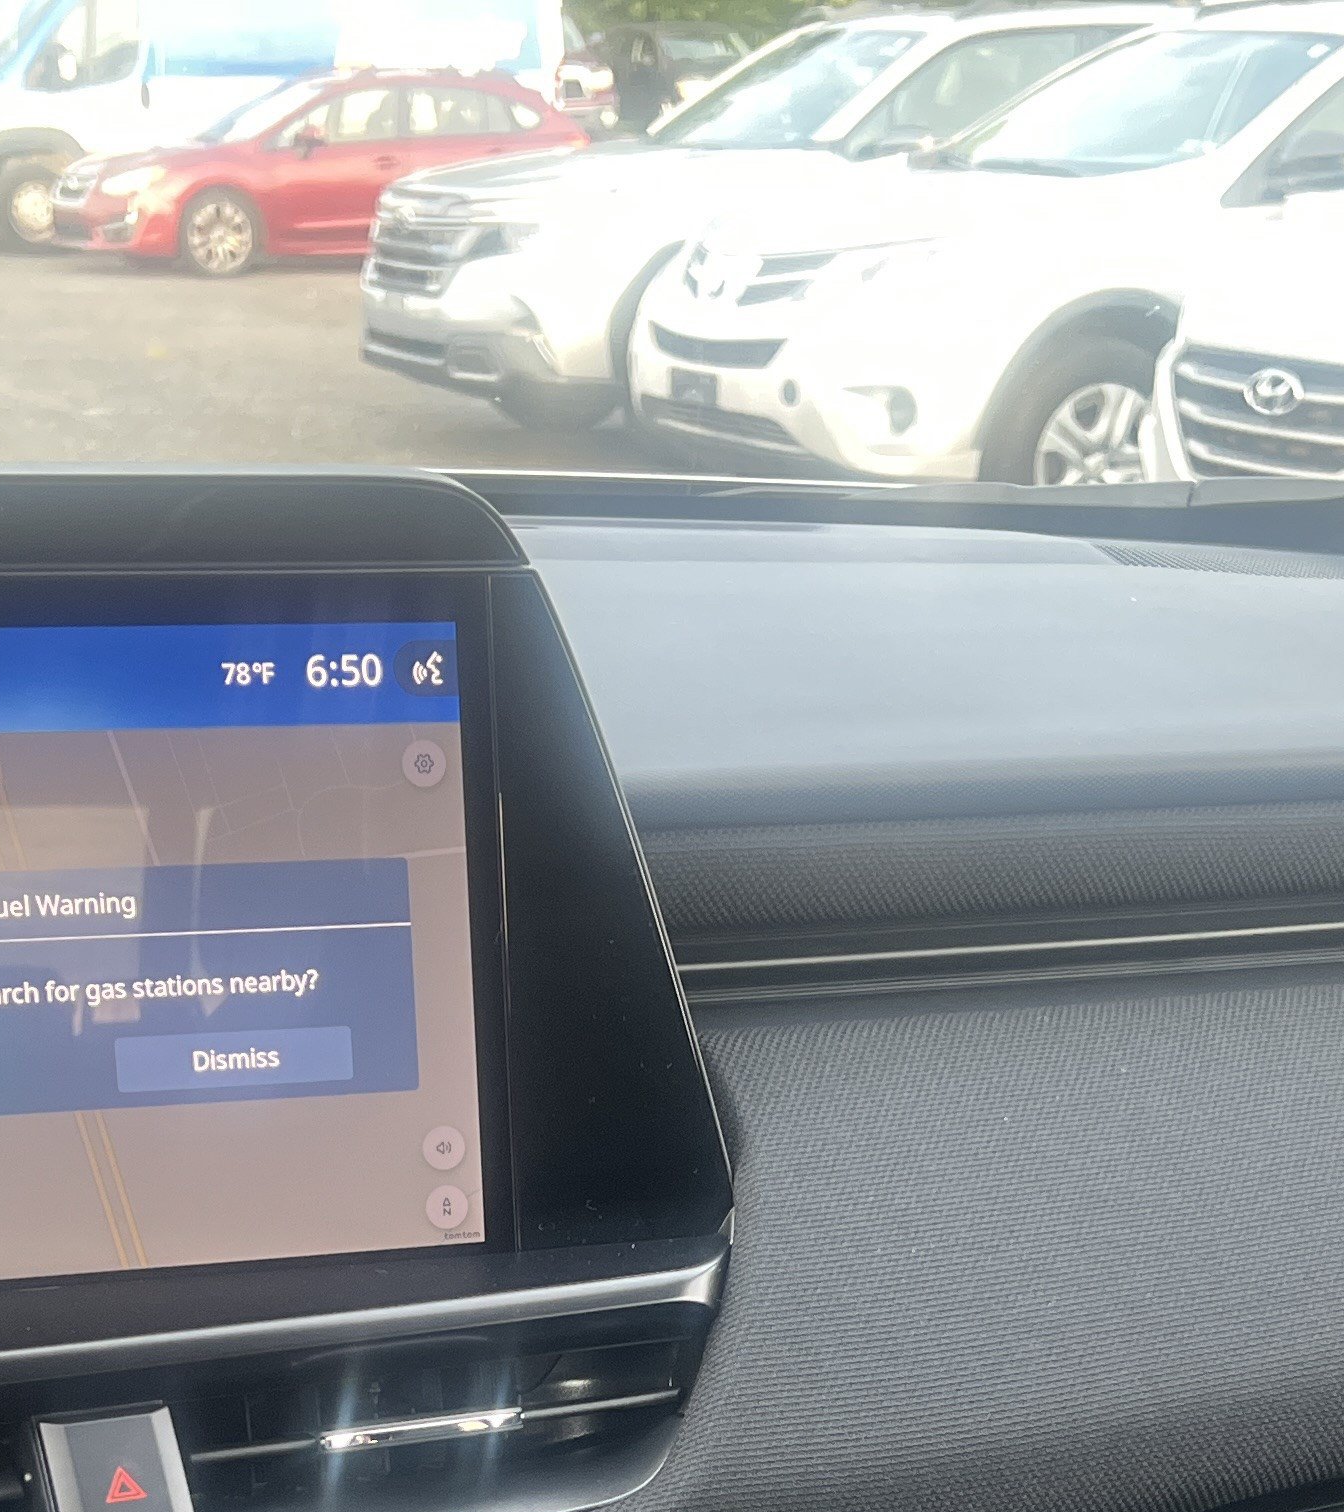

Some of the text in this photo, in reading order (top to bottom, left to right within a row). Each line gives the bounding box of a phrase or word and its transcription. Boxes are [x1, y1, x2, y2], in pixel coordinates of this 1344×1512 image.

[221, 661, 276, 686] 78°F
[306, 653, 384, 688] 6:50
[35, 892, 138, 919] Warning
[44, 979, 80, 1004] for
[85, 981, 127, 1007] gas
[132, 974, 224, 998] stations
[230, 968, 320, 997] nearby?
[192, 1047, 281, 1073] Dismiss
